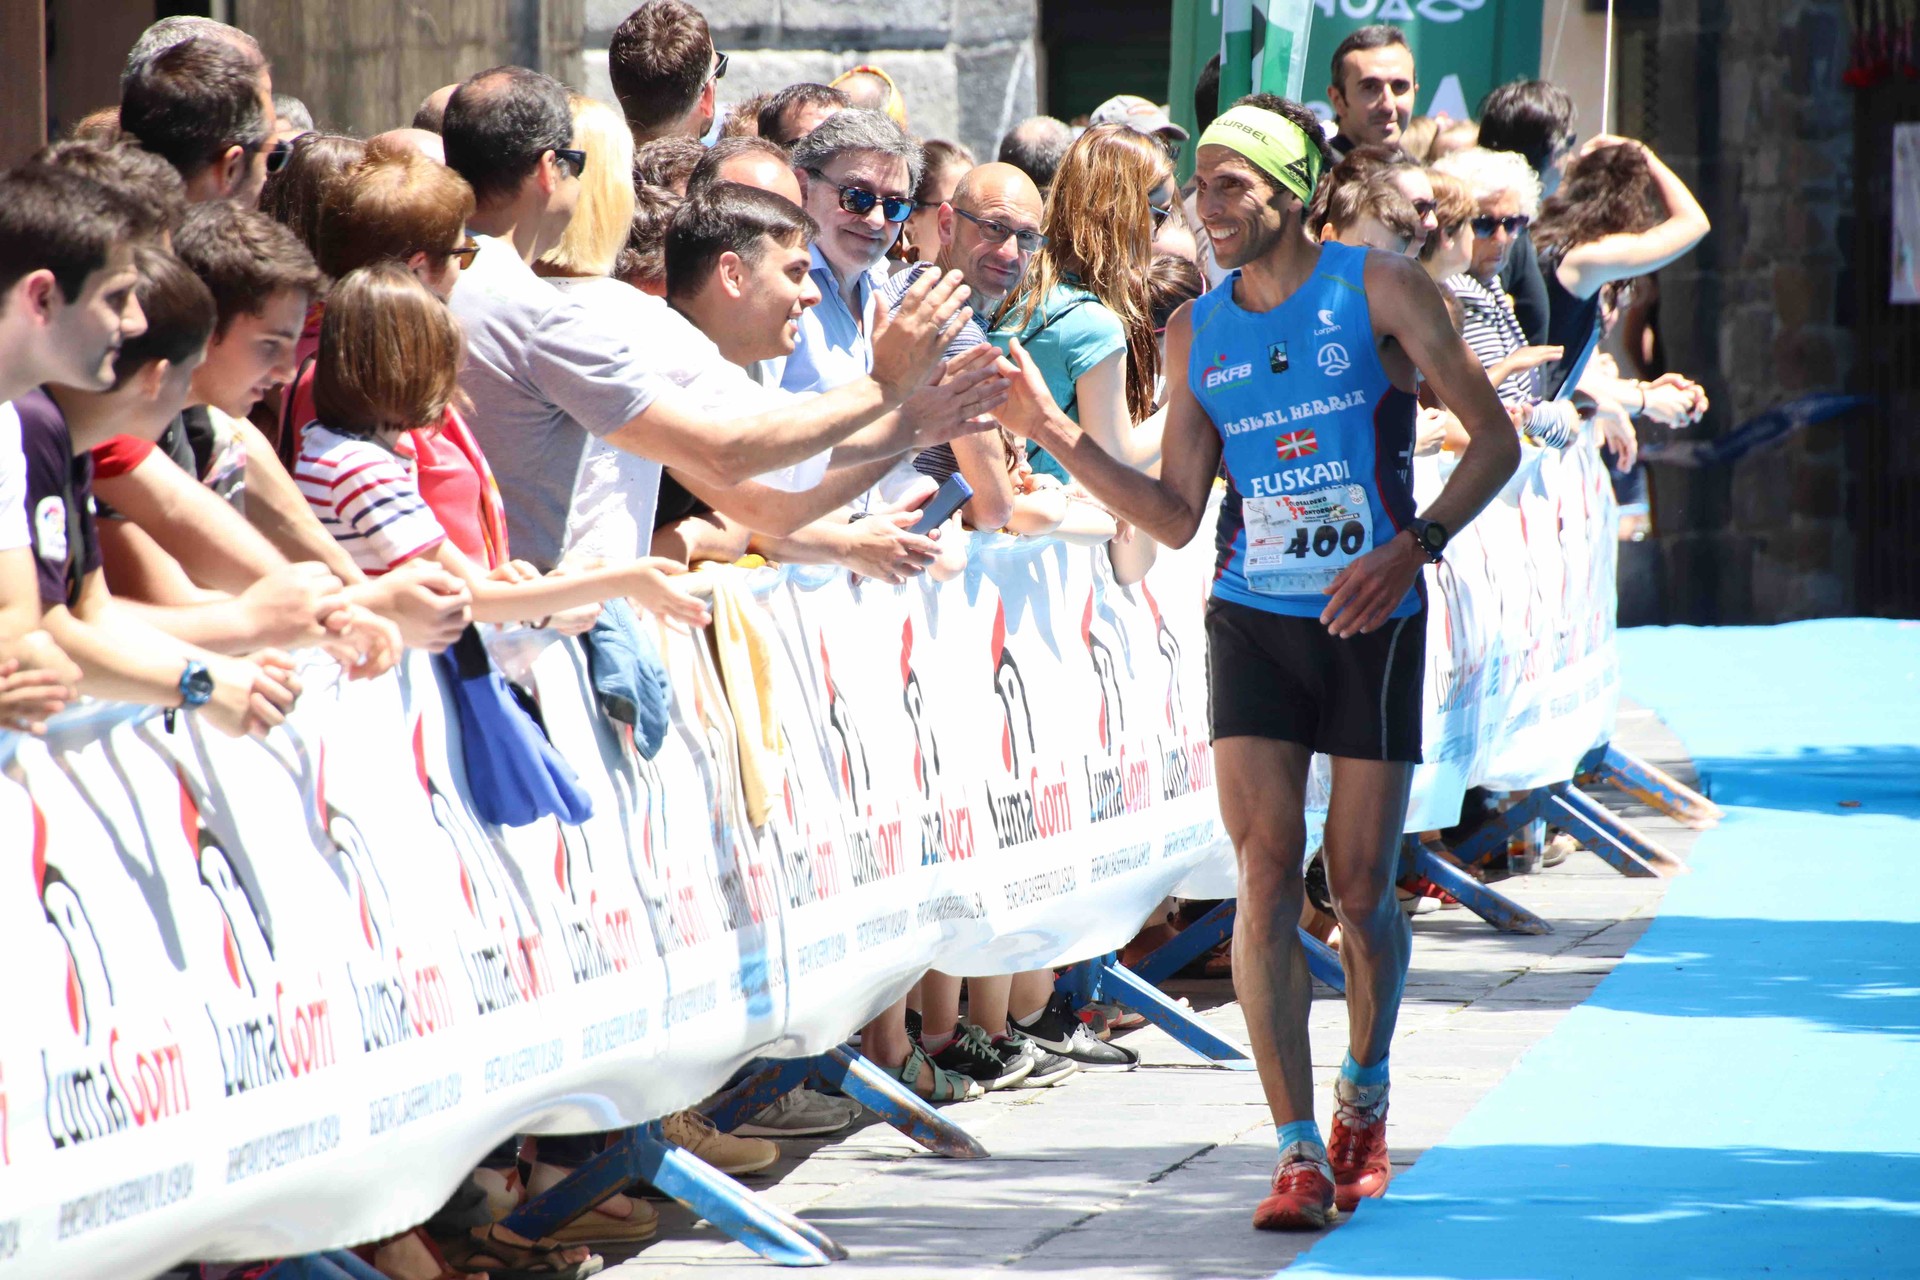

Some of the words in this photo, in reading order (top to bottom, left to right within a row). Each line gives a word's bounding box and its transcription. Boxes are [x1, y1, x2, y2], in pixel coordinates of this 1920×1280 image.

[1216, 118, 1269, 146] LURBEL
[1206, 362, 1252, 388] EKFB
[1250, 459, 1351, 498] EUSKADI
[1284, 520, 1366, 559] 400
